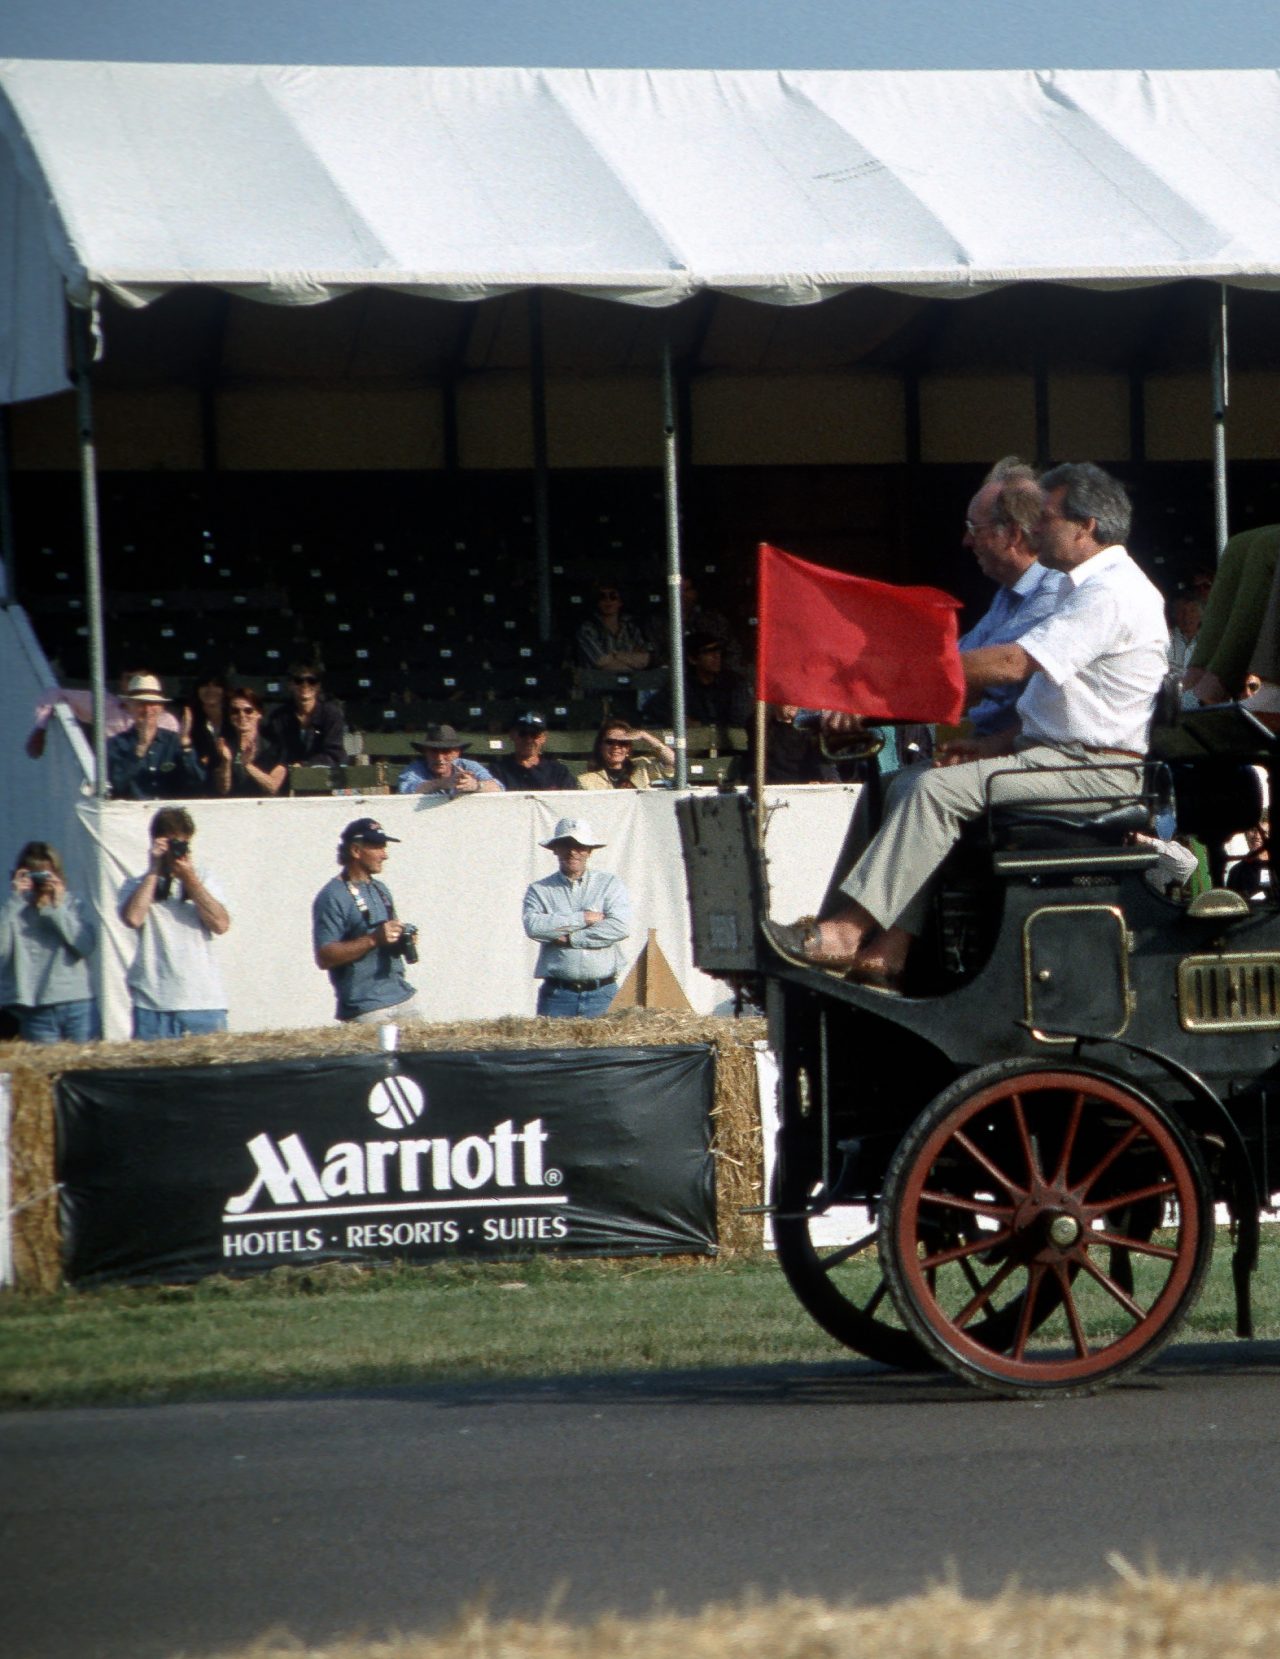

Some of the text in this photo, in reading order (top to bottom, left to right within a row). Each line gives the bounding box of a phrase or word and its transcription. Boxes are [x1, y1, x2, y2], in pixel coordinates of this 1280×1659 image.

[224, 1118, 549, 1214] Marriott
[222, 1216, 568, 1257] HOTELS RESORTS SUITES
